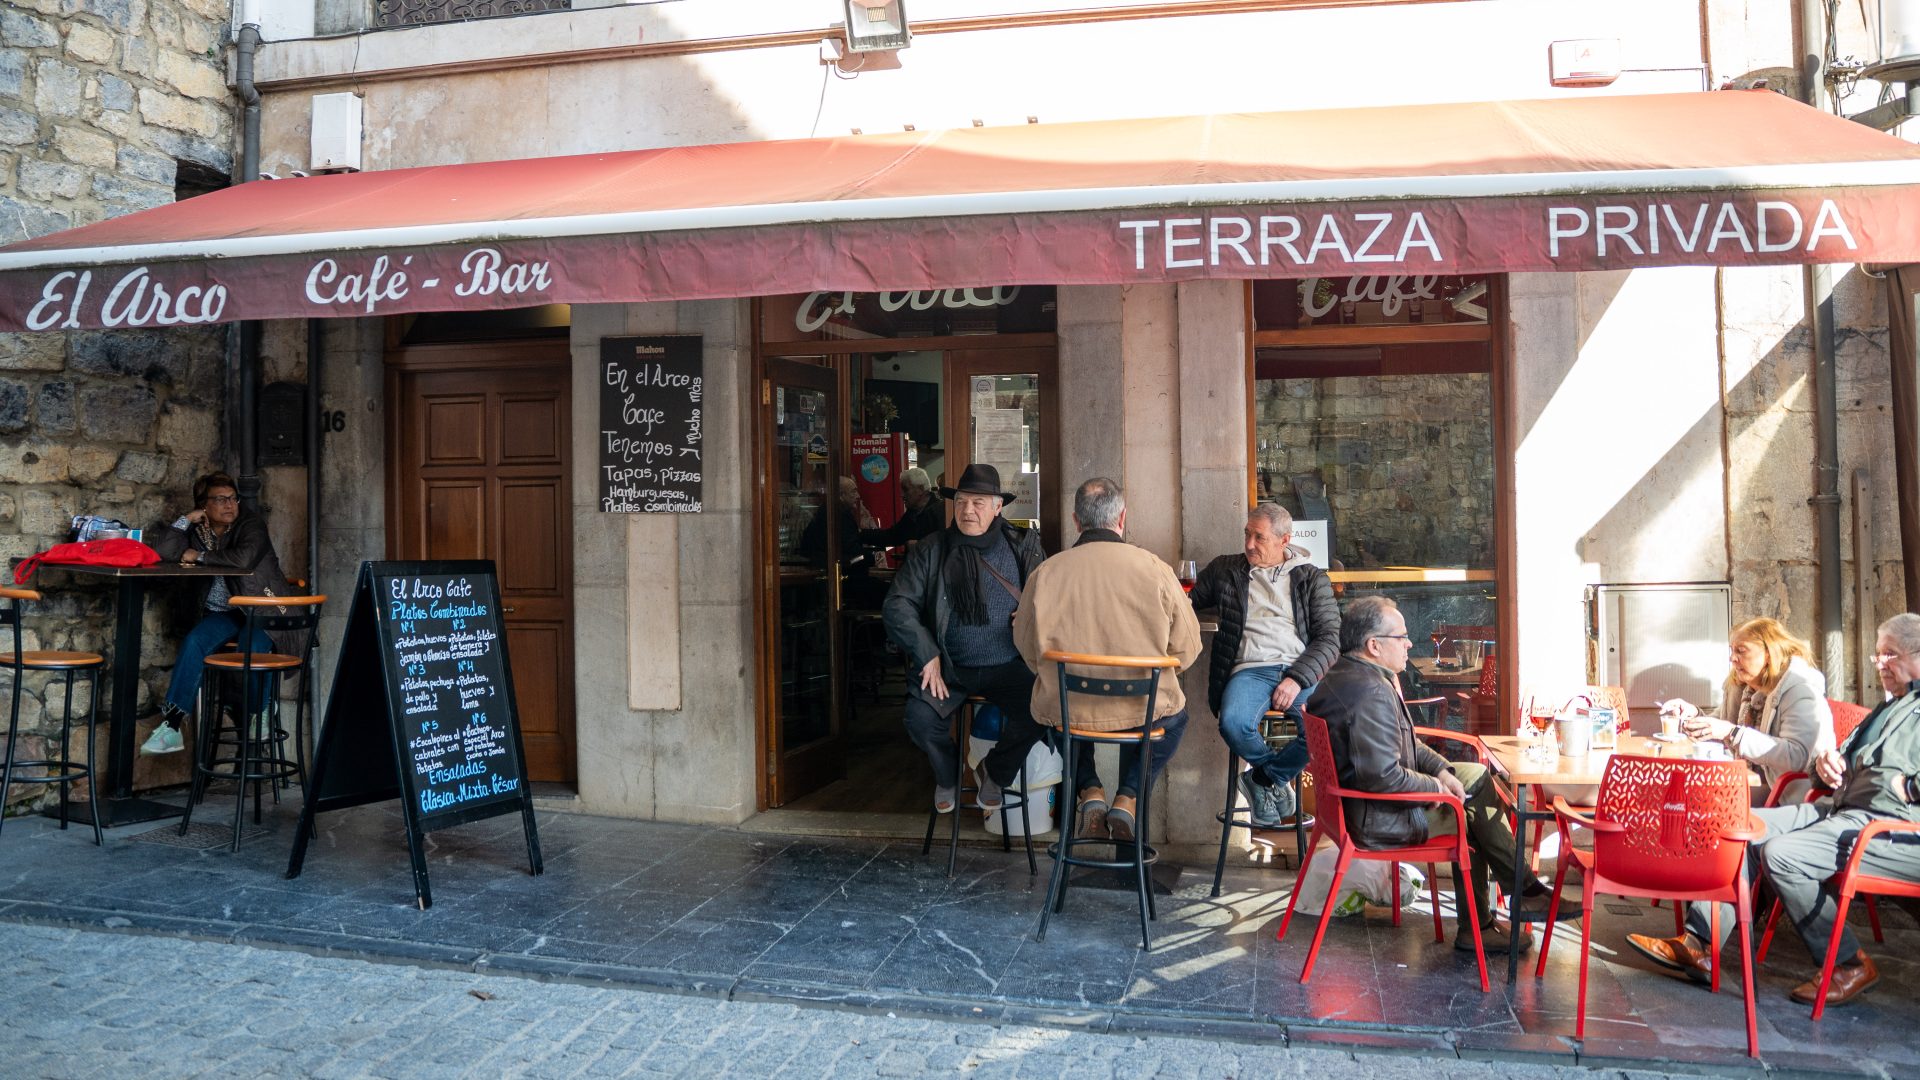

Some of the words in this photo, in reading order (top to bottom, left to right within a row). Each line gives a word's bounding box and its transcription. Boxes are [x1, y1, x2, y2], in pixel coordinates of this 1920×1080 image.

[1119, 210, 1444, 271] TERRAZA
[1548, 198, 1858, 258] PRIVADA
[305, 254, 413, 312] Café
[454, 247, 553, 298] Bar
[25, 266, 93, 331] El
[101, 265, 228, 327] Arco
[606, 362, 629, 393] En
[636, 364, 648, 386] el
[651, 363, 690, 387] Arco
[321, 410, 346, 433] 16
[622, 393, 666, 435] Cafe
[602, 430, 673, 463] Tenemos
[852, 447, 871, 455] bien
[854, 437, 887, 446] ¡Tómala
[602, 465, 658, 487] Tapas,
[609, 482, 689, 502] Hamburguesas,
[602, 496, 640, 513] Platos
[644, 496, 702, 513] combinados
[391, 578, 408, 599] El
[412, 578, 443, 599] Arco
[446, 577, 472, 598] Cafe
[391, 600, 428, 620] Platos
[429, 599, 487, 619] Combinados
[405, 692, 414, 704] de
[414, 690, 430, 705] pollo
[432, 692, 438, 703] y
[459, 687, 486, 699] huevos
[488, 685, 495, 697] y
[405, 701, 438, 715] ensalada
[447, 743, 460, 753] con
[429, 760, 487, 785] Ensaladas
